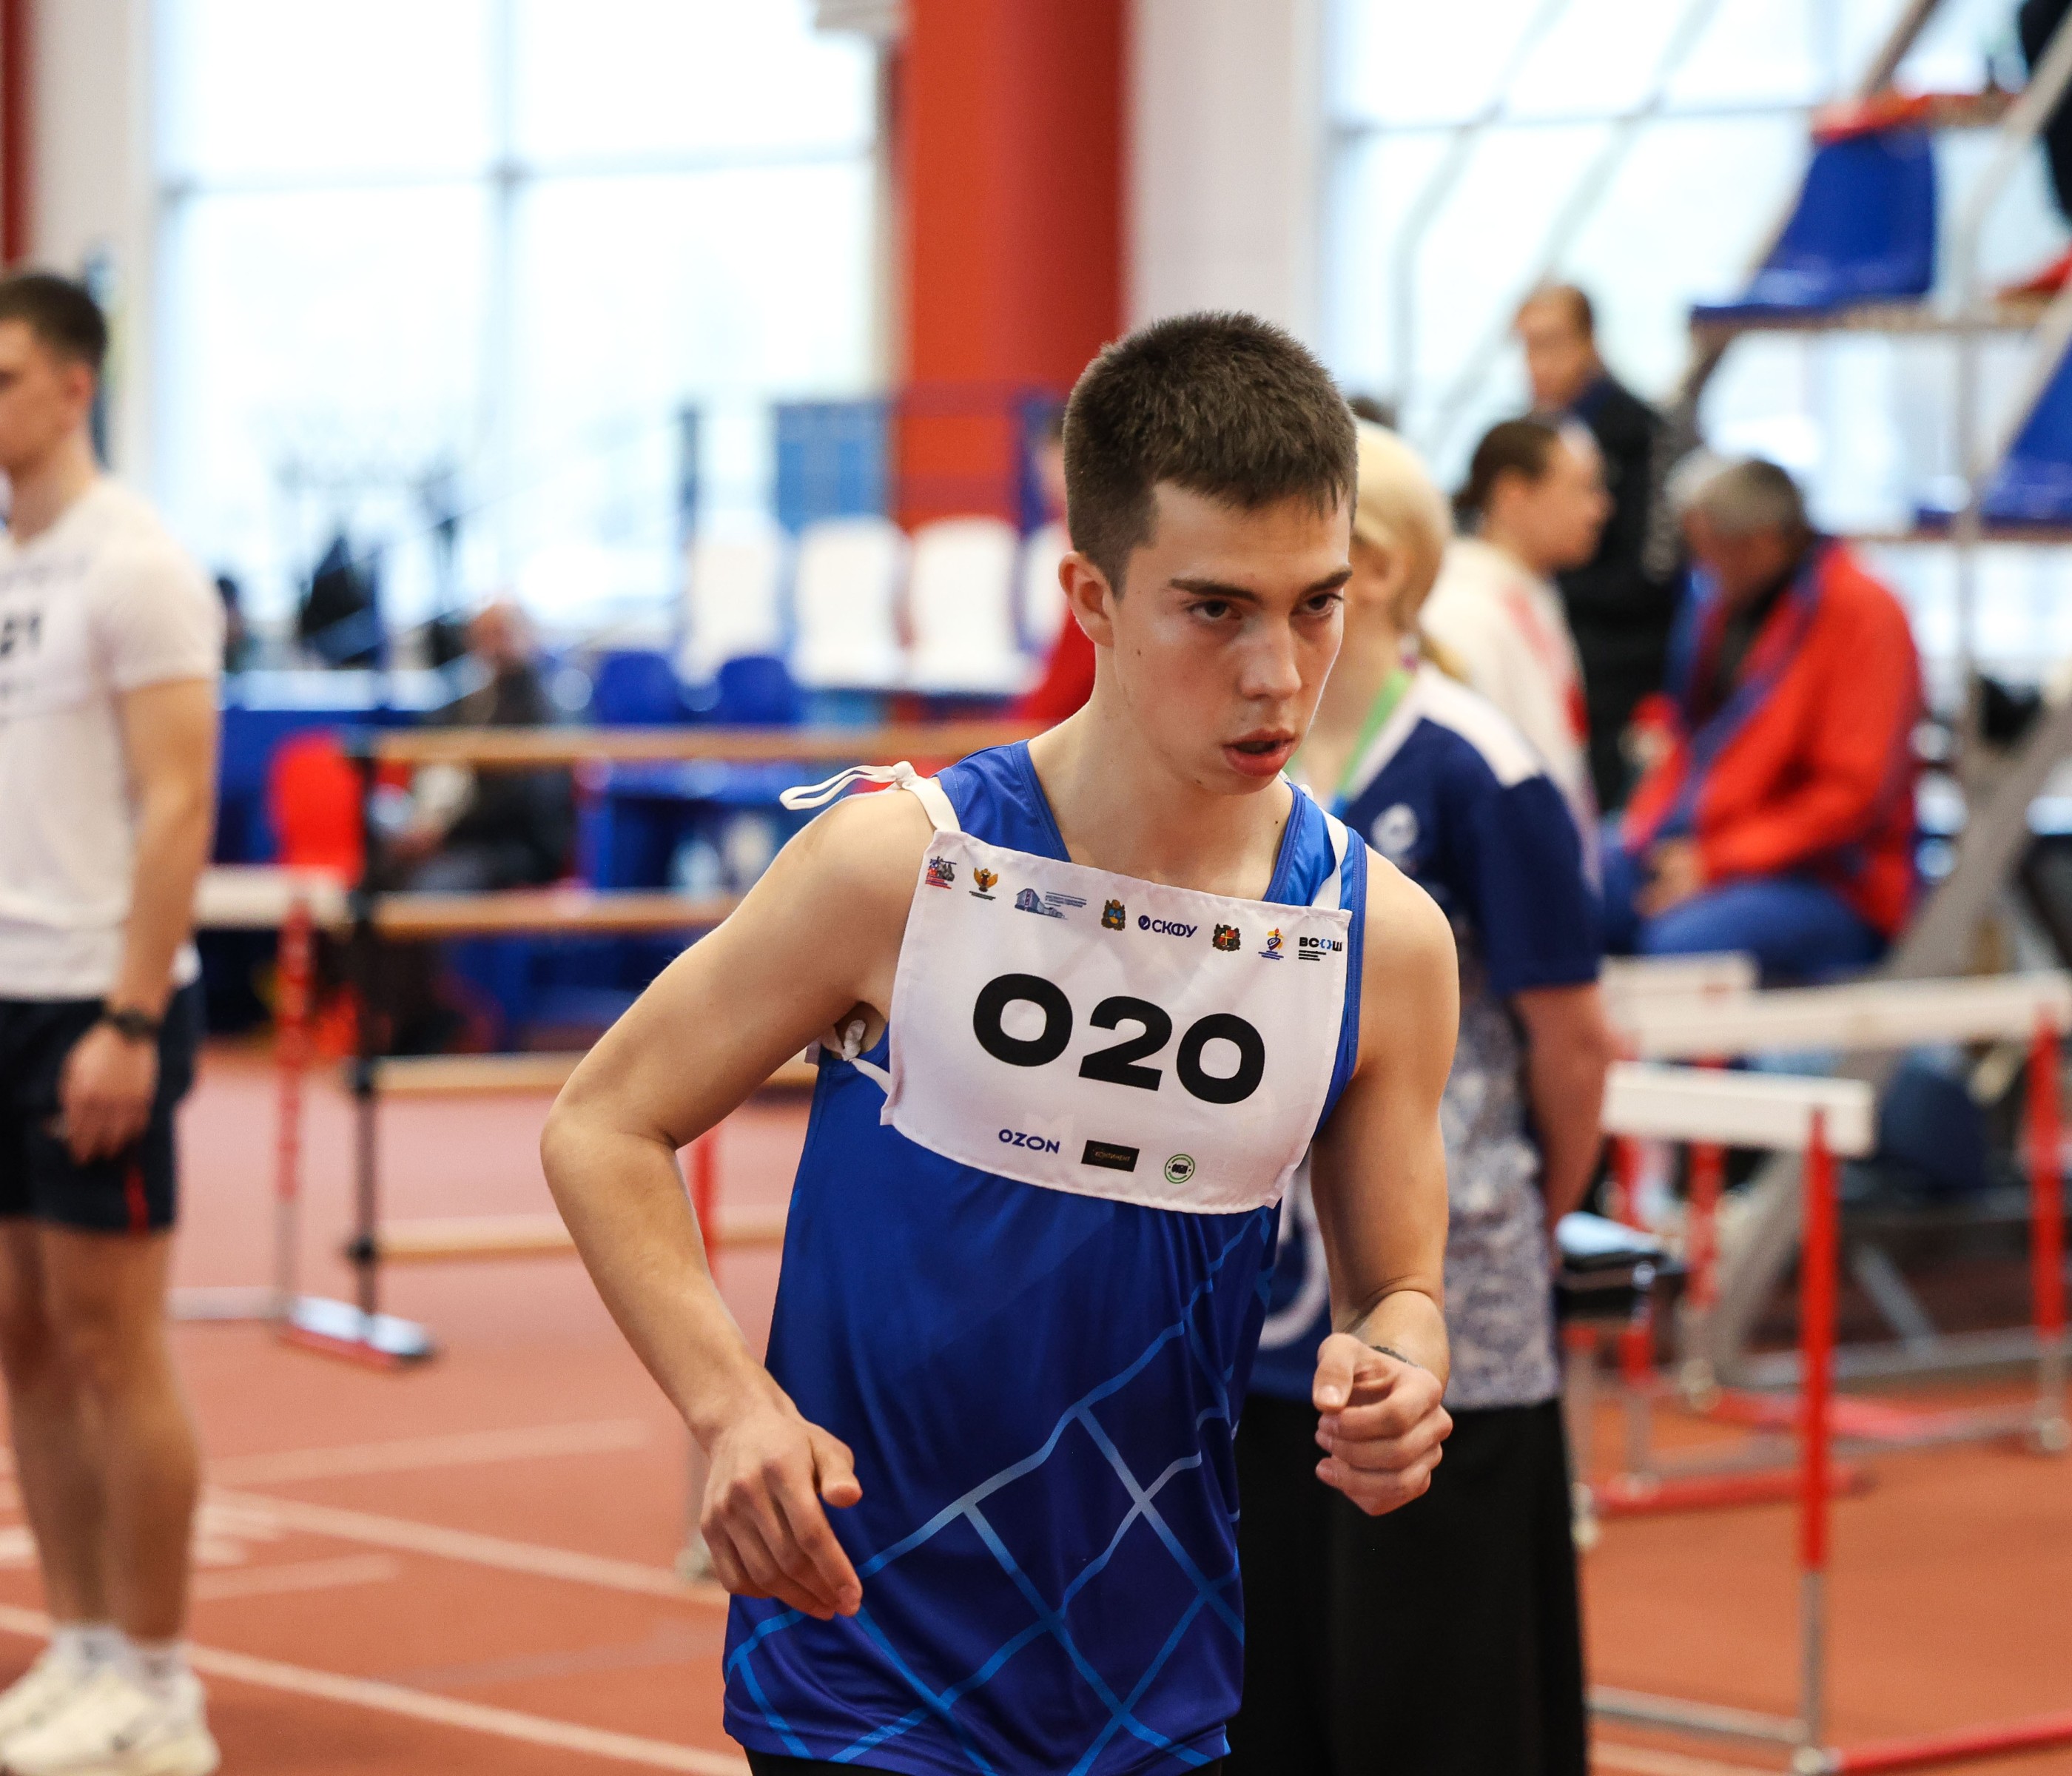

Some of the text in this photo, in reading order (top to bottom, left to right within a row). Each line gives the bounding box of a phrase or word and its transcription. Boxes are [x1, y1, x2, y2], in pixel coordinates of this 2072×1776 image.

[1152, 919, 1198, 938] СКФУ
[973, 973, 1265, 1105] 020
[998, 1128, 1060, 1154] OZON
